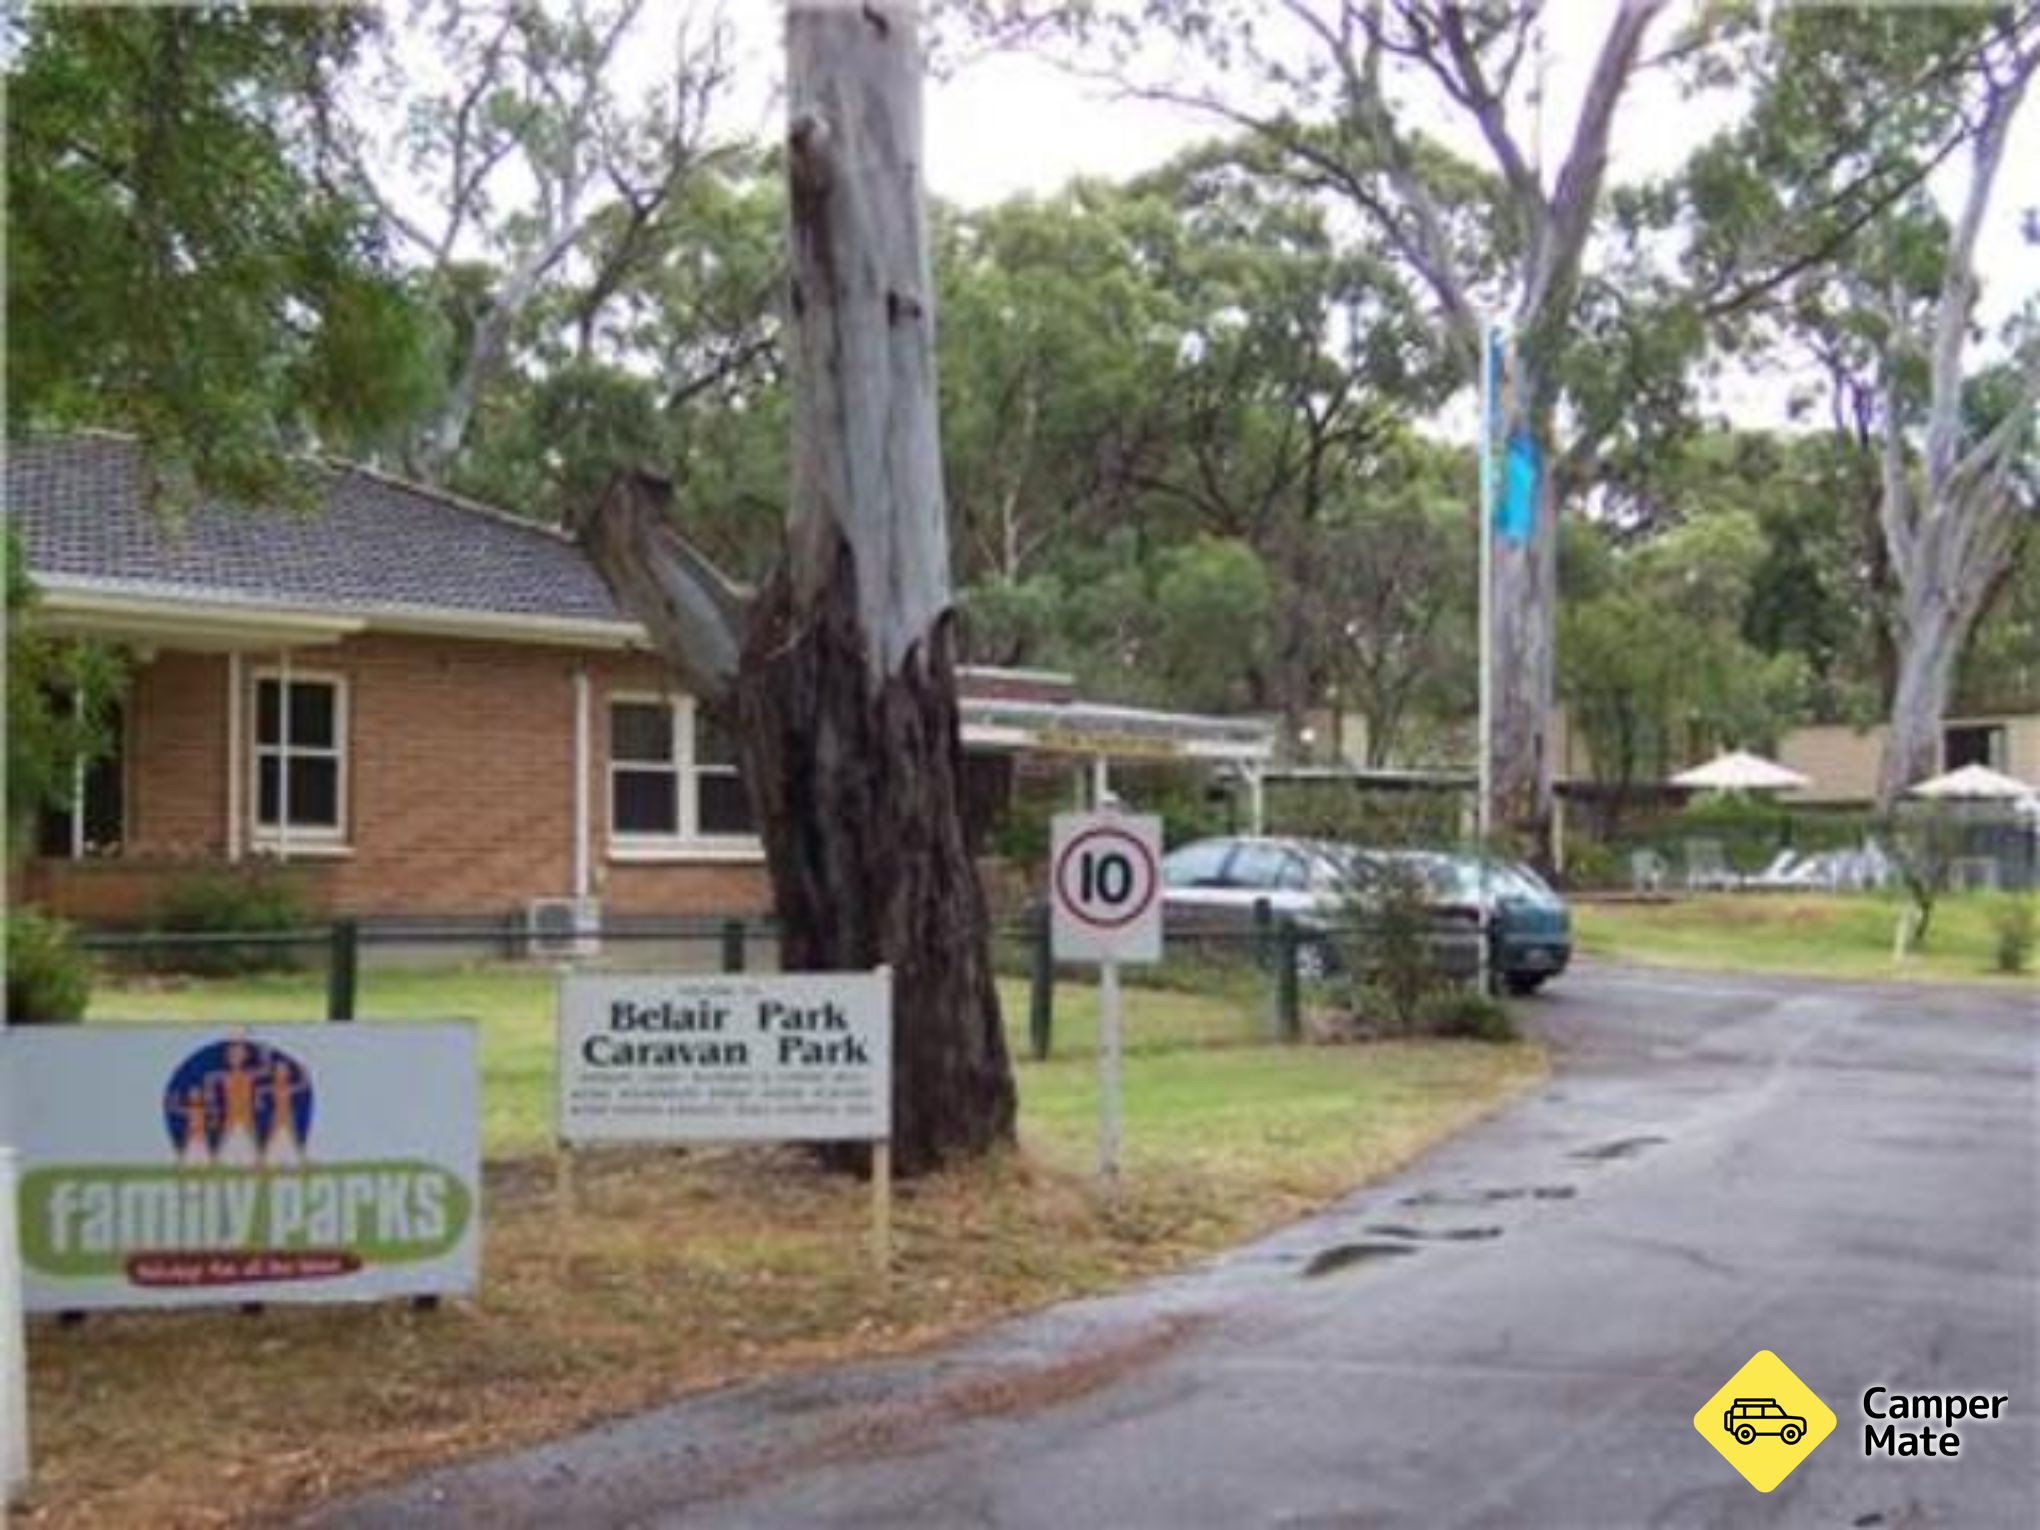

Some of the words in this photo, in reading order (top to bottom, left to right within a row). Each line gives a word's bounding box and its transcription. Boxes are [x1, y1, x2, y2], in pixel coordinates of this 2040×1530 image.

[1080, 852, 1133, 906] 10
[609, 1000, 731, 1031] Belair
[757, 1000, 848, 1031] Park
[581, 1035, 748, 1067] Caravan
[776, 1035, 869, 1066] Park
[48, 1178, 256, 1254] family
[269, 1171, 447, 1247] parks
